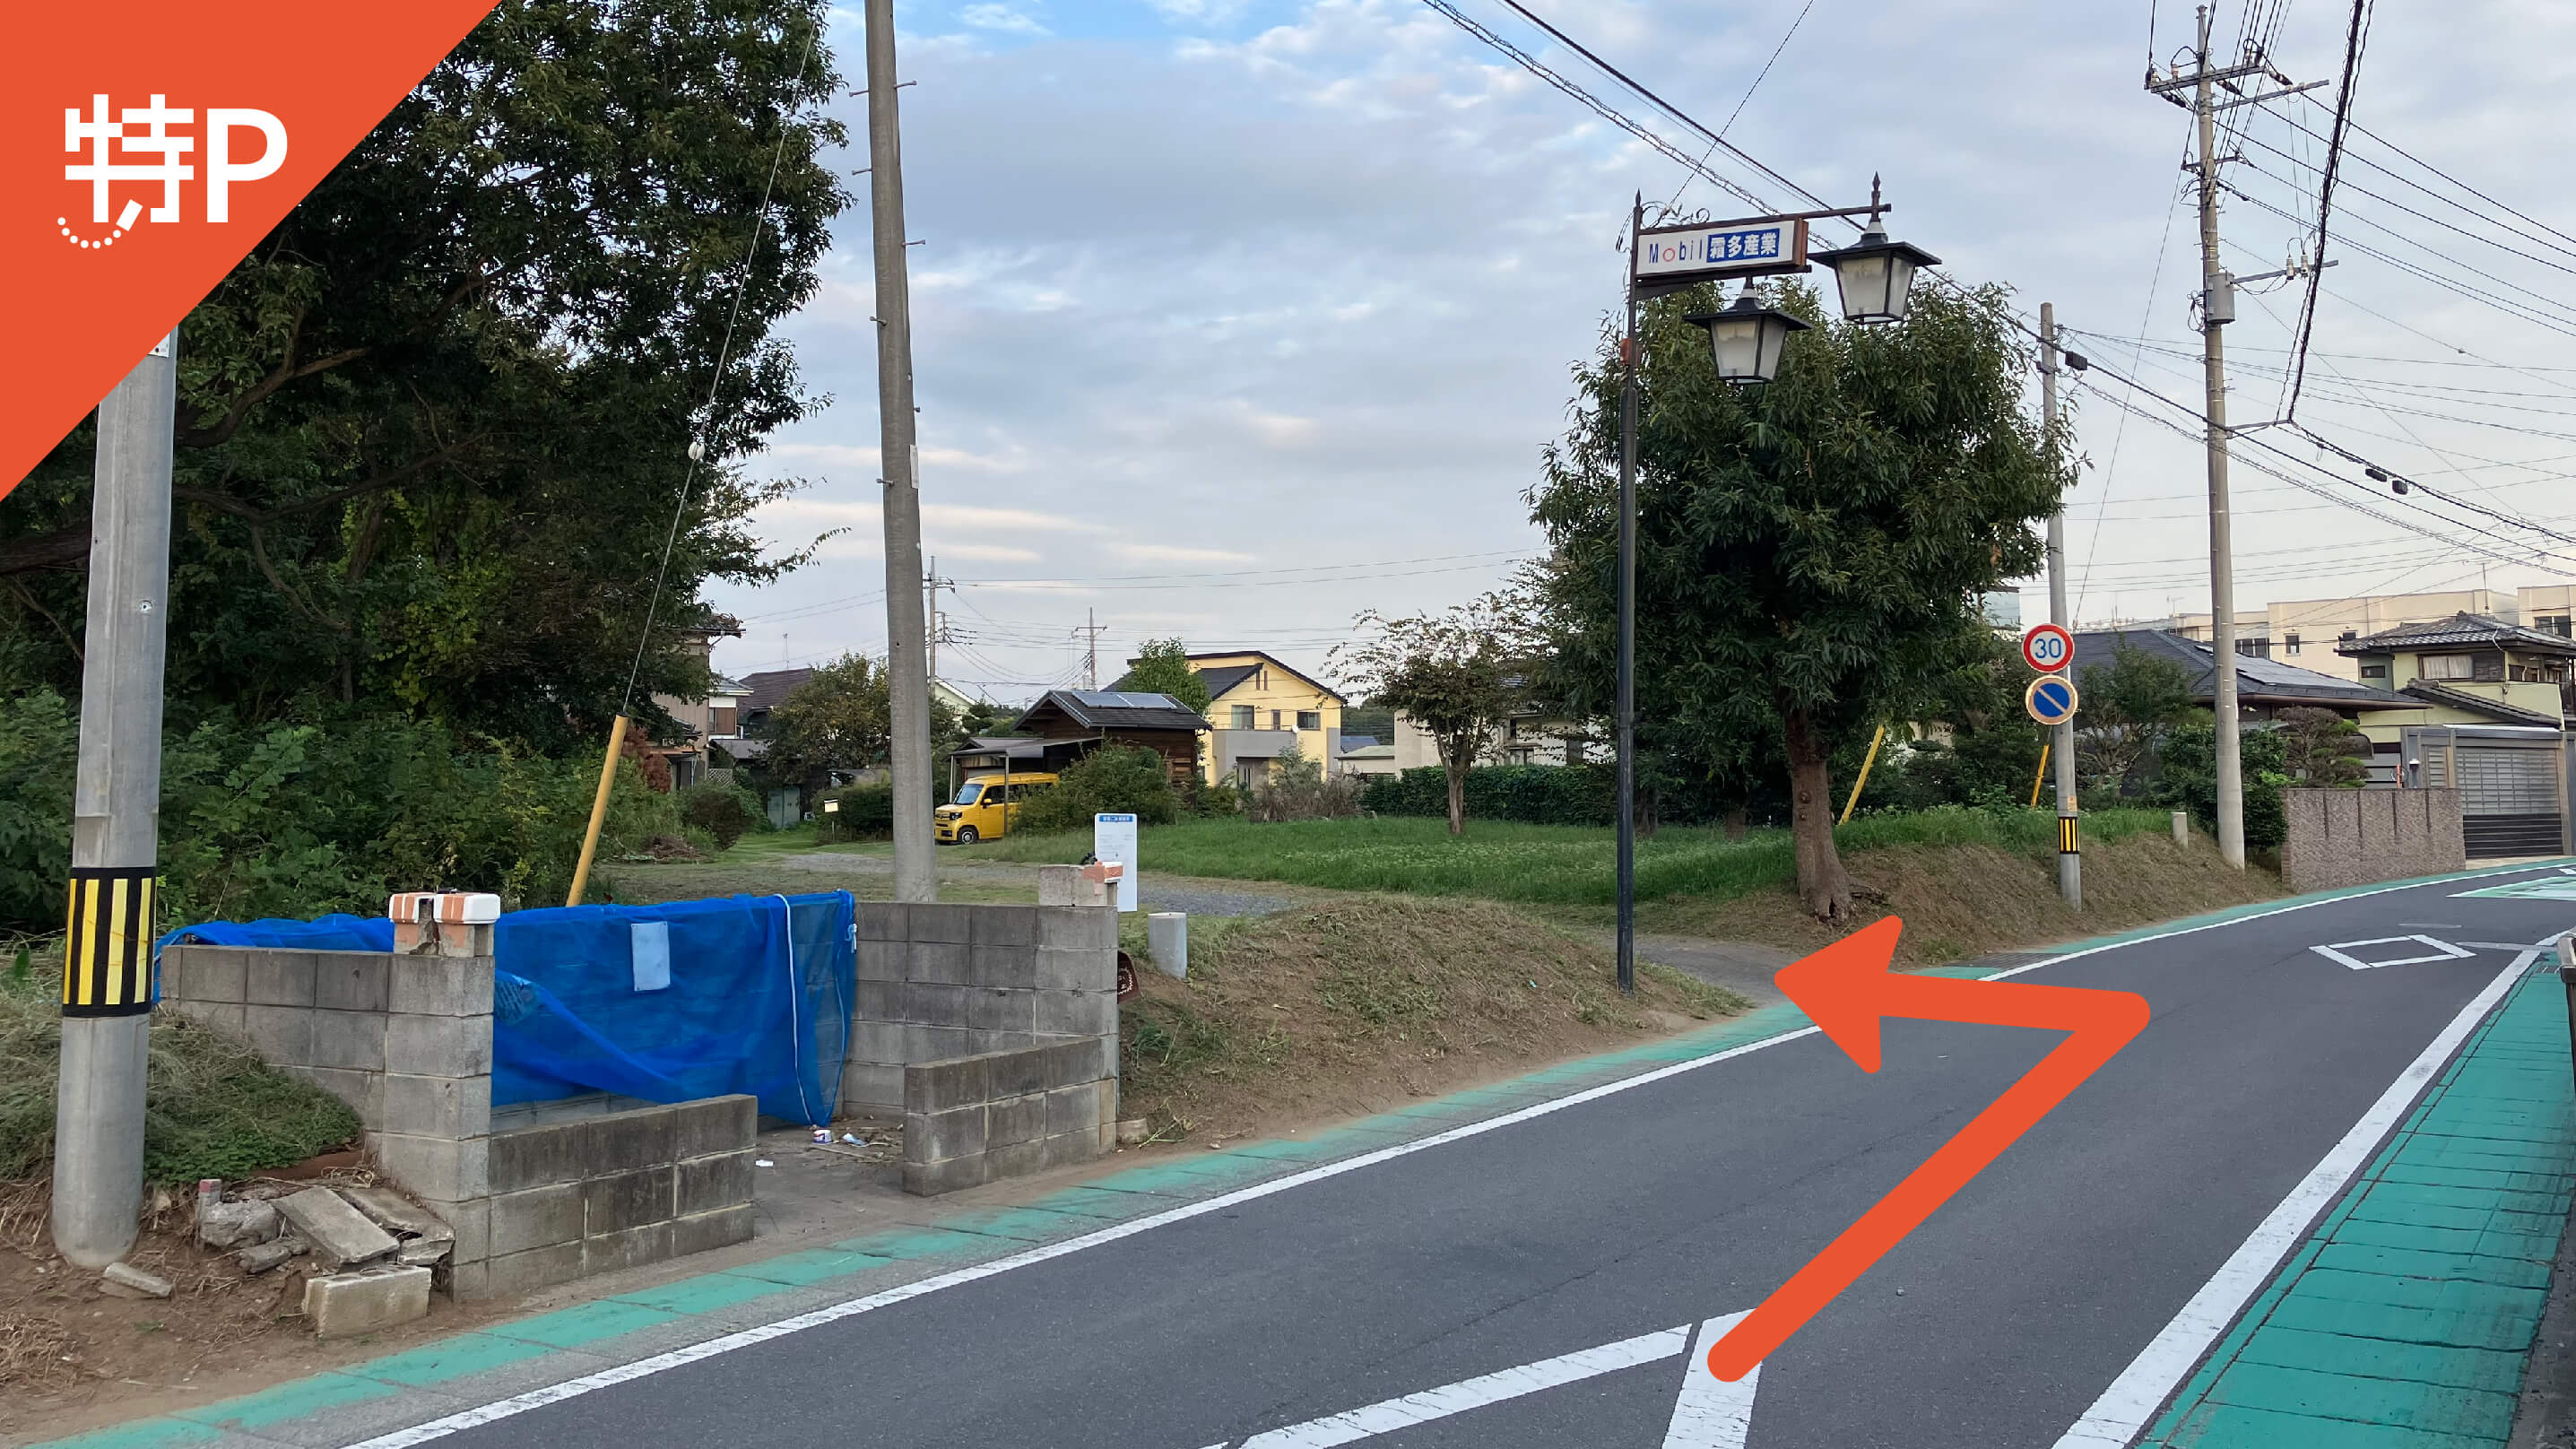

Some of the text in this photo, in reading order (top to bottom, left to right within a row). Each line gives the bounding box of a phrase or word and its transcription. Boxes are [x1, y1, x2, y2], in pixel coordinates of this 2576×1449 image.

[1648, 232, 1777, 264] Mobil 霜多産業
[2034, 638, 2062, 659] 30
